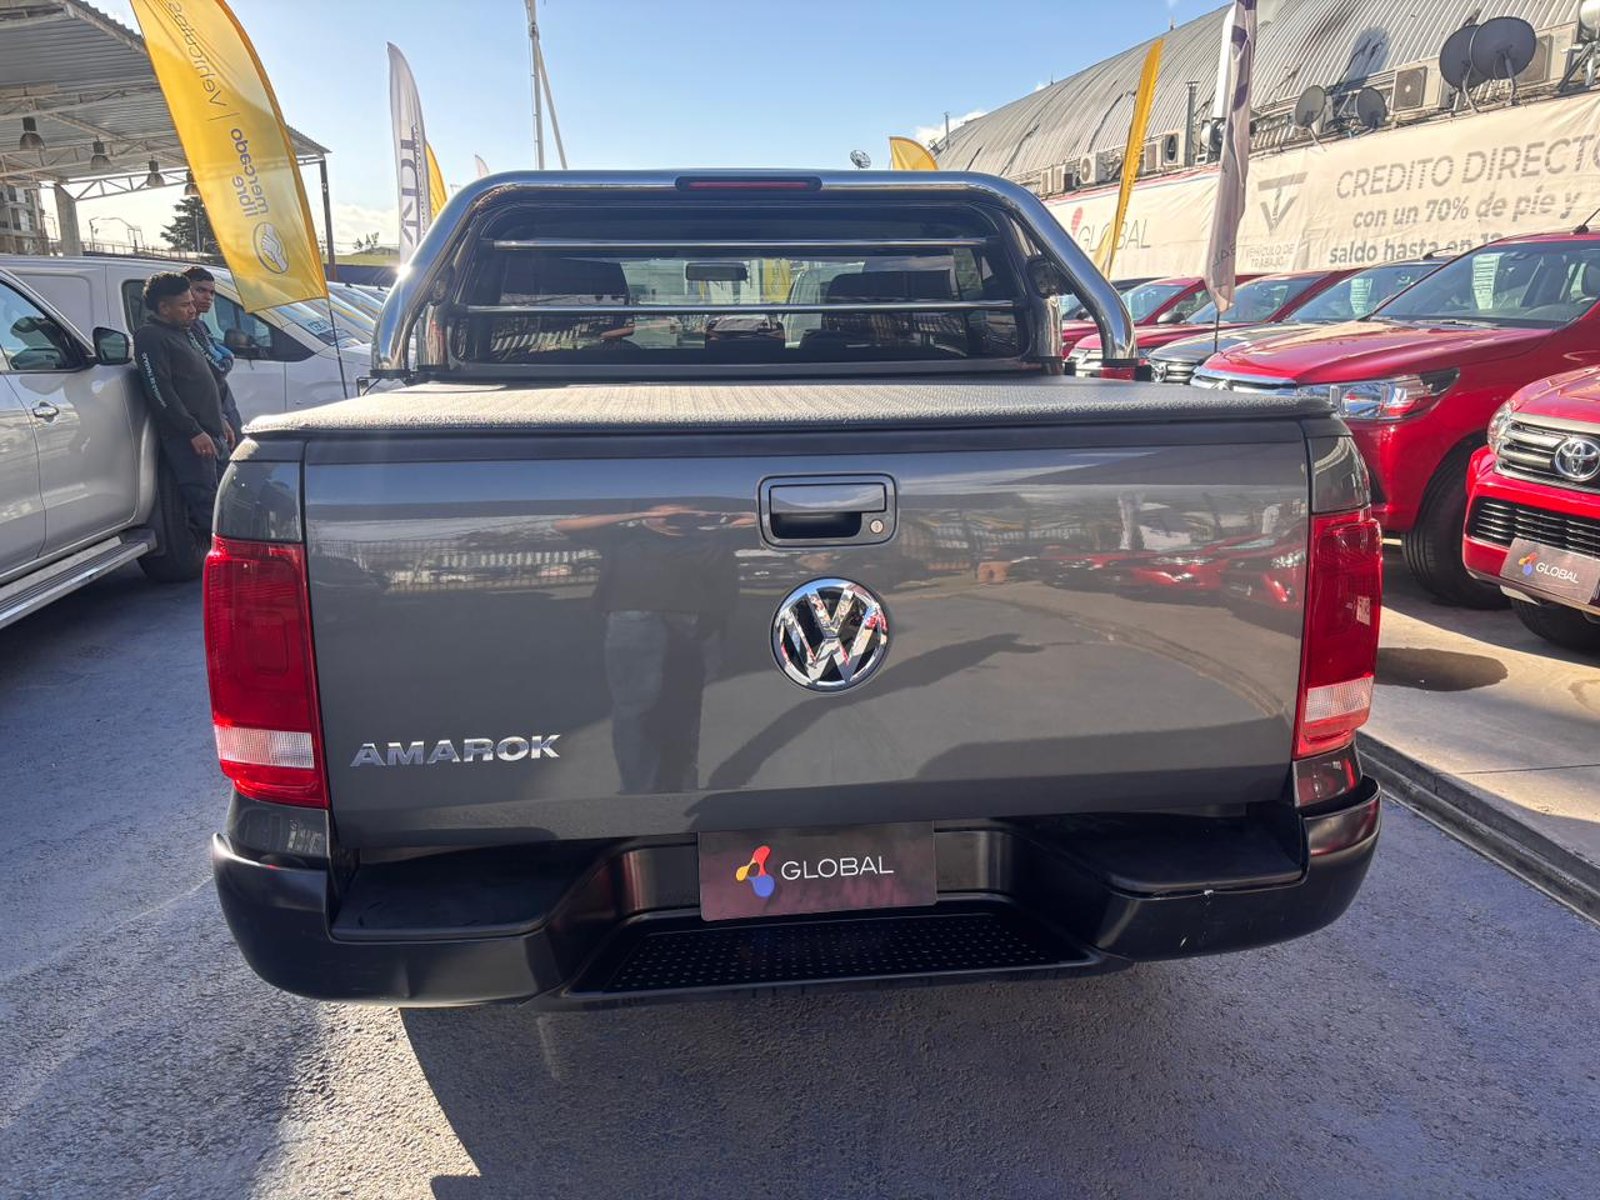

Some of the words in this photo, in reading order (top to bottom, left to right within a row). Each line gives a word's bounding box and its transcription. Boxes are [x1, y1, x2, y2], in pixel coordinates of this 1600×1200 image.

[1336, 155, 1454, 200] CREDITO
[1352, 207, 1387, 229] con
[1392, 204, 1419, 226] un
[1425, 197, 1470, 223] 70%
[1475, 190, 1509, 219] de
[1560, 191, 1582, 220] y
[1329, 240, 1378, 265] saldo
[1535, 562, 1579, 584] GLOBAL
[350, 734, 561, 767] AMAROK
[781, 855, 894, 881] GLOBAL
